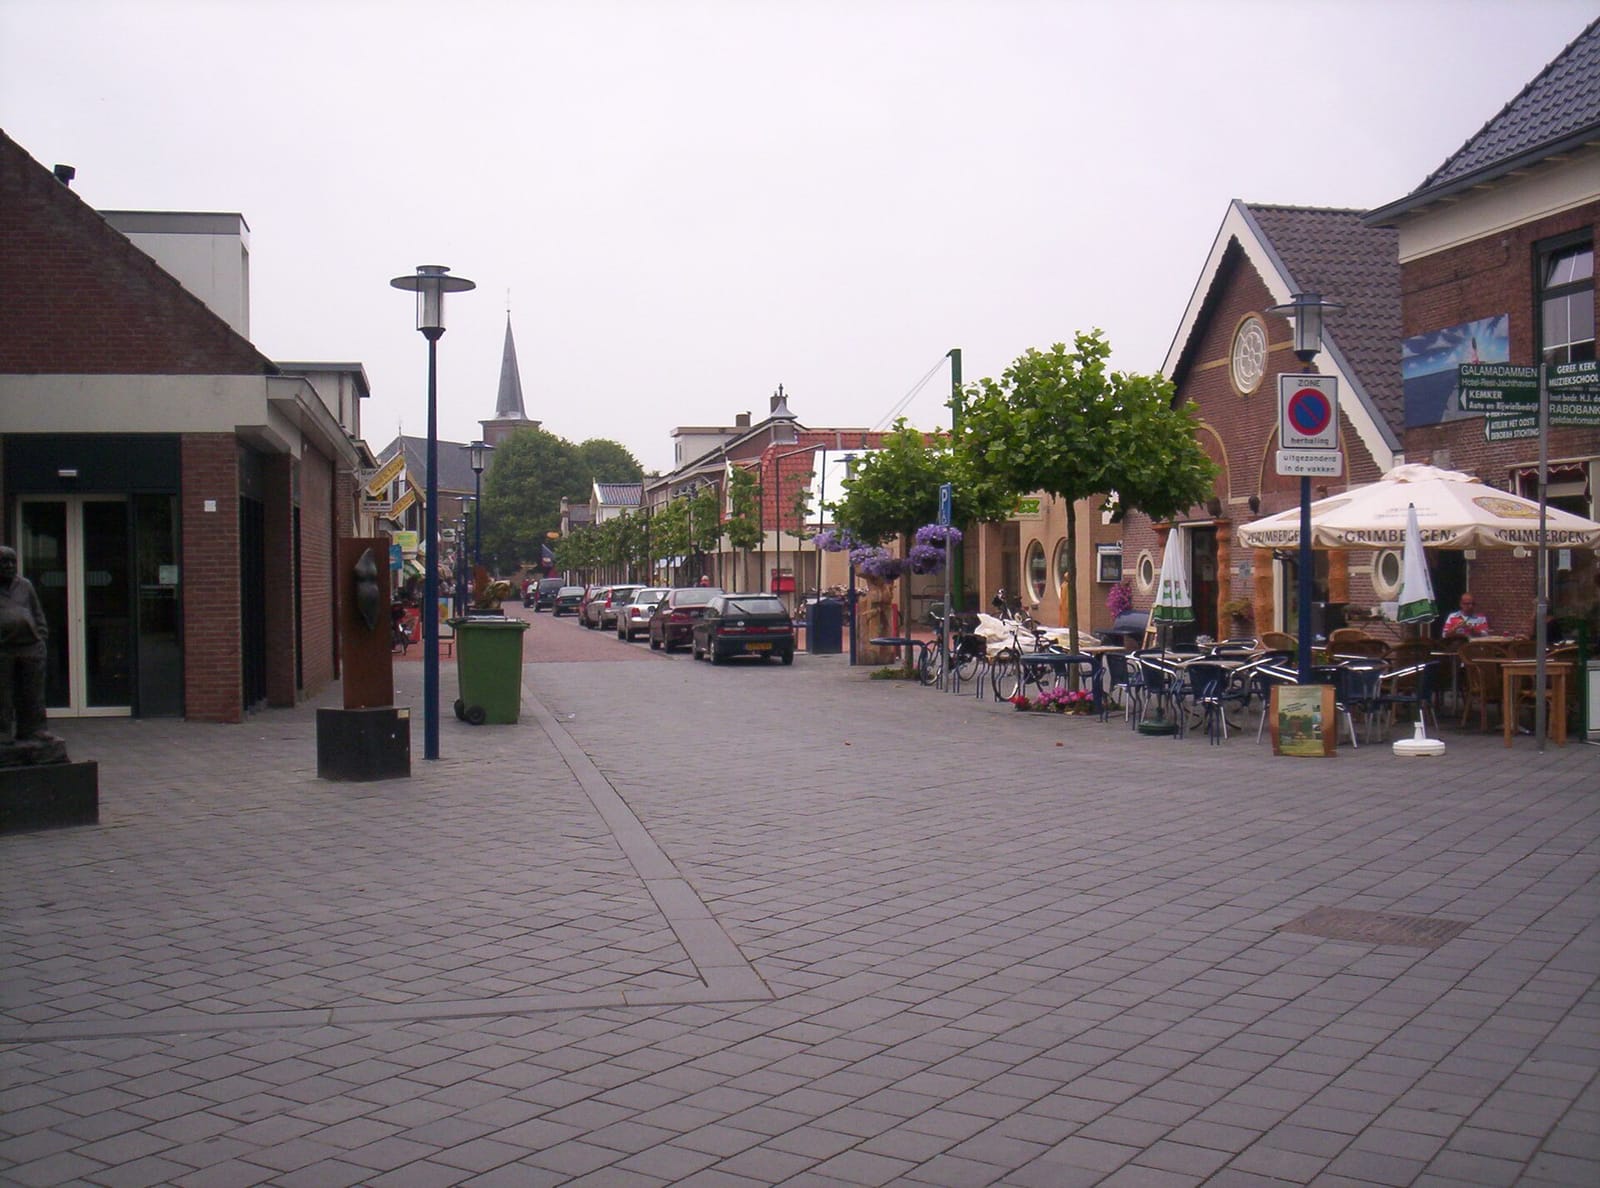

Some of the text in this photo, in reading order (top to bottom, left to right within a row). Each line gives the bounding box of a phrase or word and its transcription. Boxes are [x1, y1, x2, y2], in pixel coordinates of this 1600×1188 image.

[1461, 365, 1538, 377] GALAMADAMMEN
[1579, 362, 1597, 371] KERK
[1298, 379, 1321, 387] ZONE
[1548, 374, 1599, 387] MUZIEKSCHOOL
[1468, 390, 1503, 399] KEMKER
[1291, 437, 1329, 446] herhaling
[1283, 455, 1337, 464] uitgezonderd
[1295, 464, 1304, 472] de
[942, 489, 948, 510] P
[1251, 530, 1300, 543] GRIMBERGE
[1344, 529, 1451, 543] GRIMBEGEN
